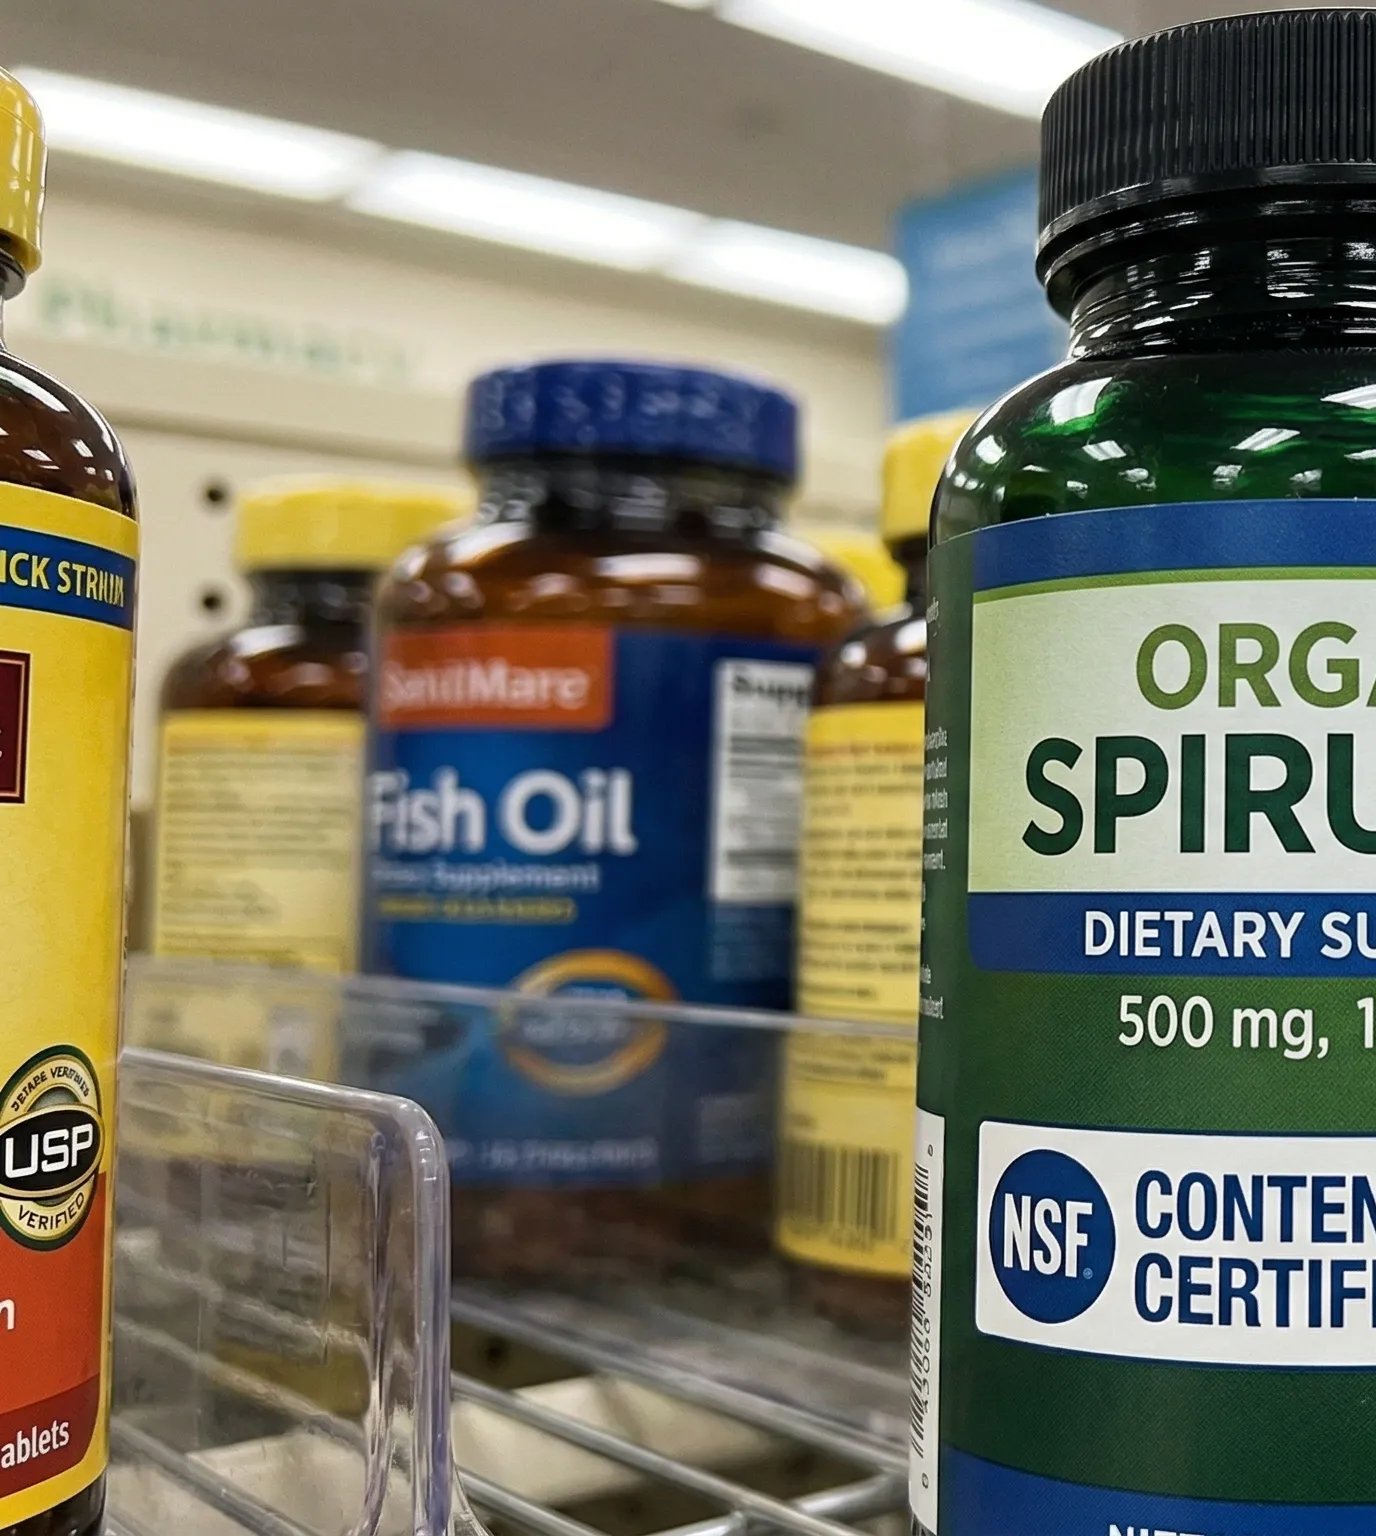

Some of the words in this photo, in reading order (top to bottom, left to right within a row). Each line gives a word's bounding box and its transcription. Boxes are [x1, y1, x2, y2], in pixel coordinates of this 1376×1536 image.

[367, 767, 487, 854] Fish
[500, 767, 638, 857] Oil
[1083, 909, 1306, 959] DIETARY
[1117, 995, 1213, 1048] 500
[1231, 1006, 1331, 1060] mg,
[5, 1122, 94, 1179] USP
[18, 1191, 85, 1231] VERIFIED
[1003, 1191, 1093, 1279] NSF
